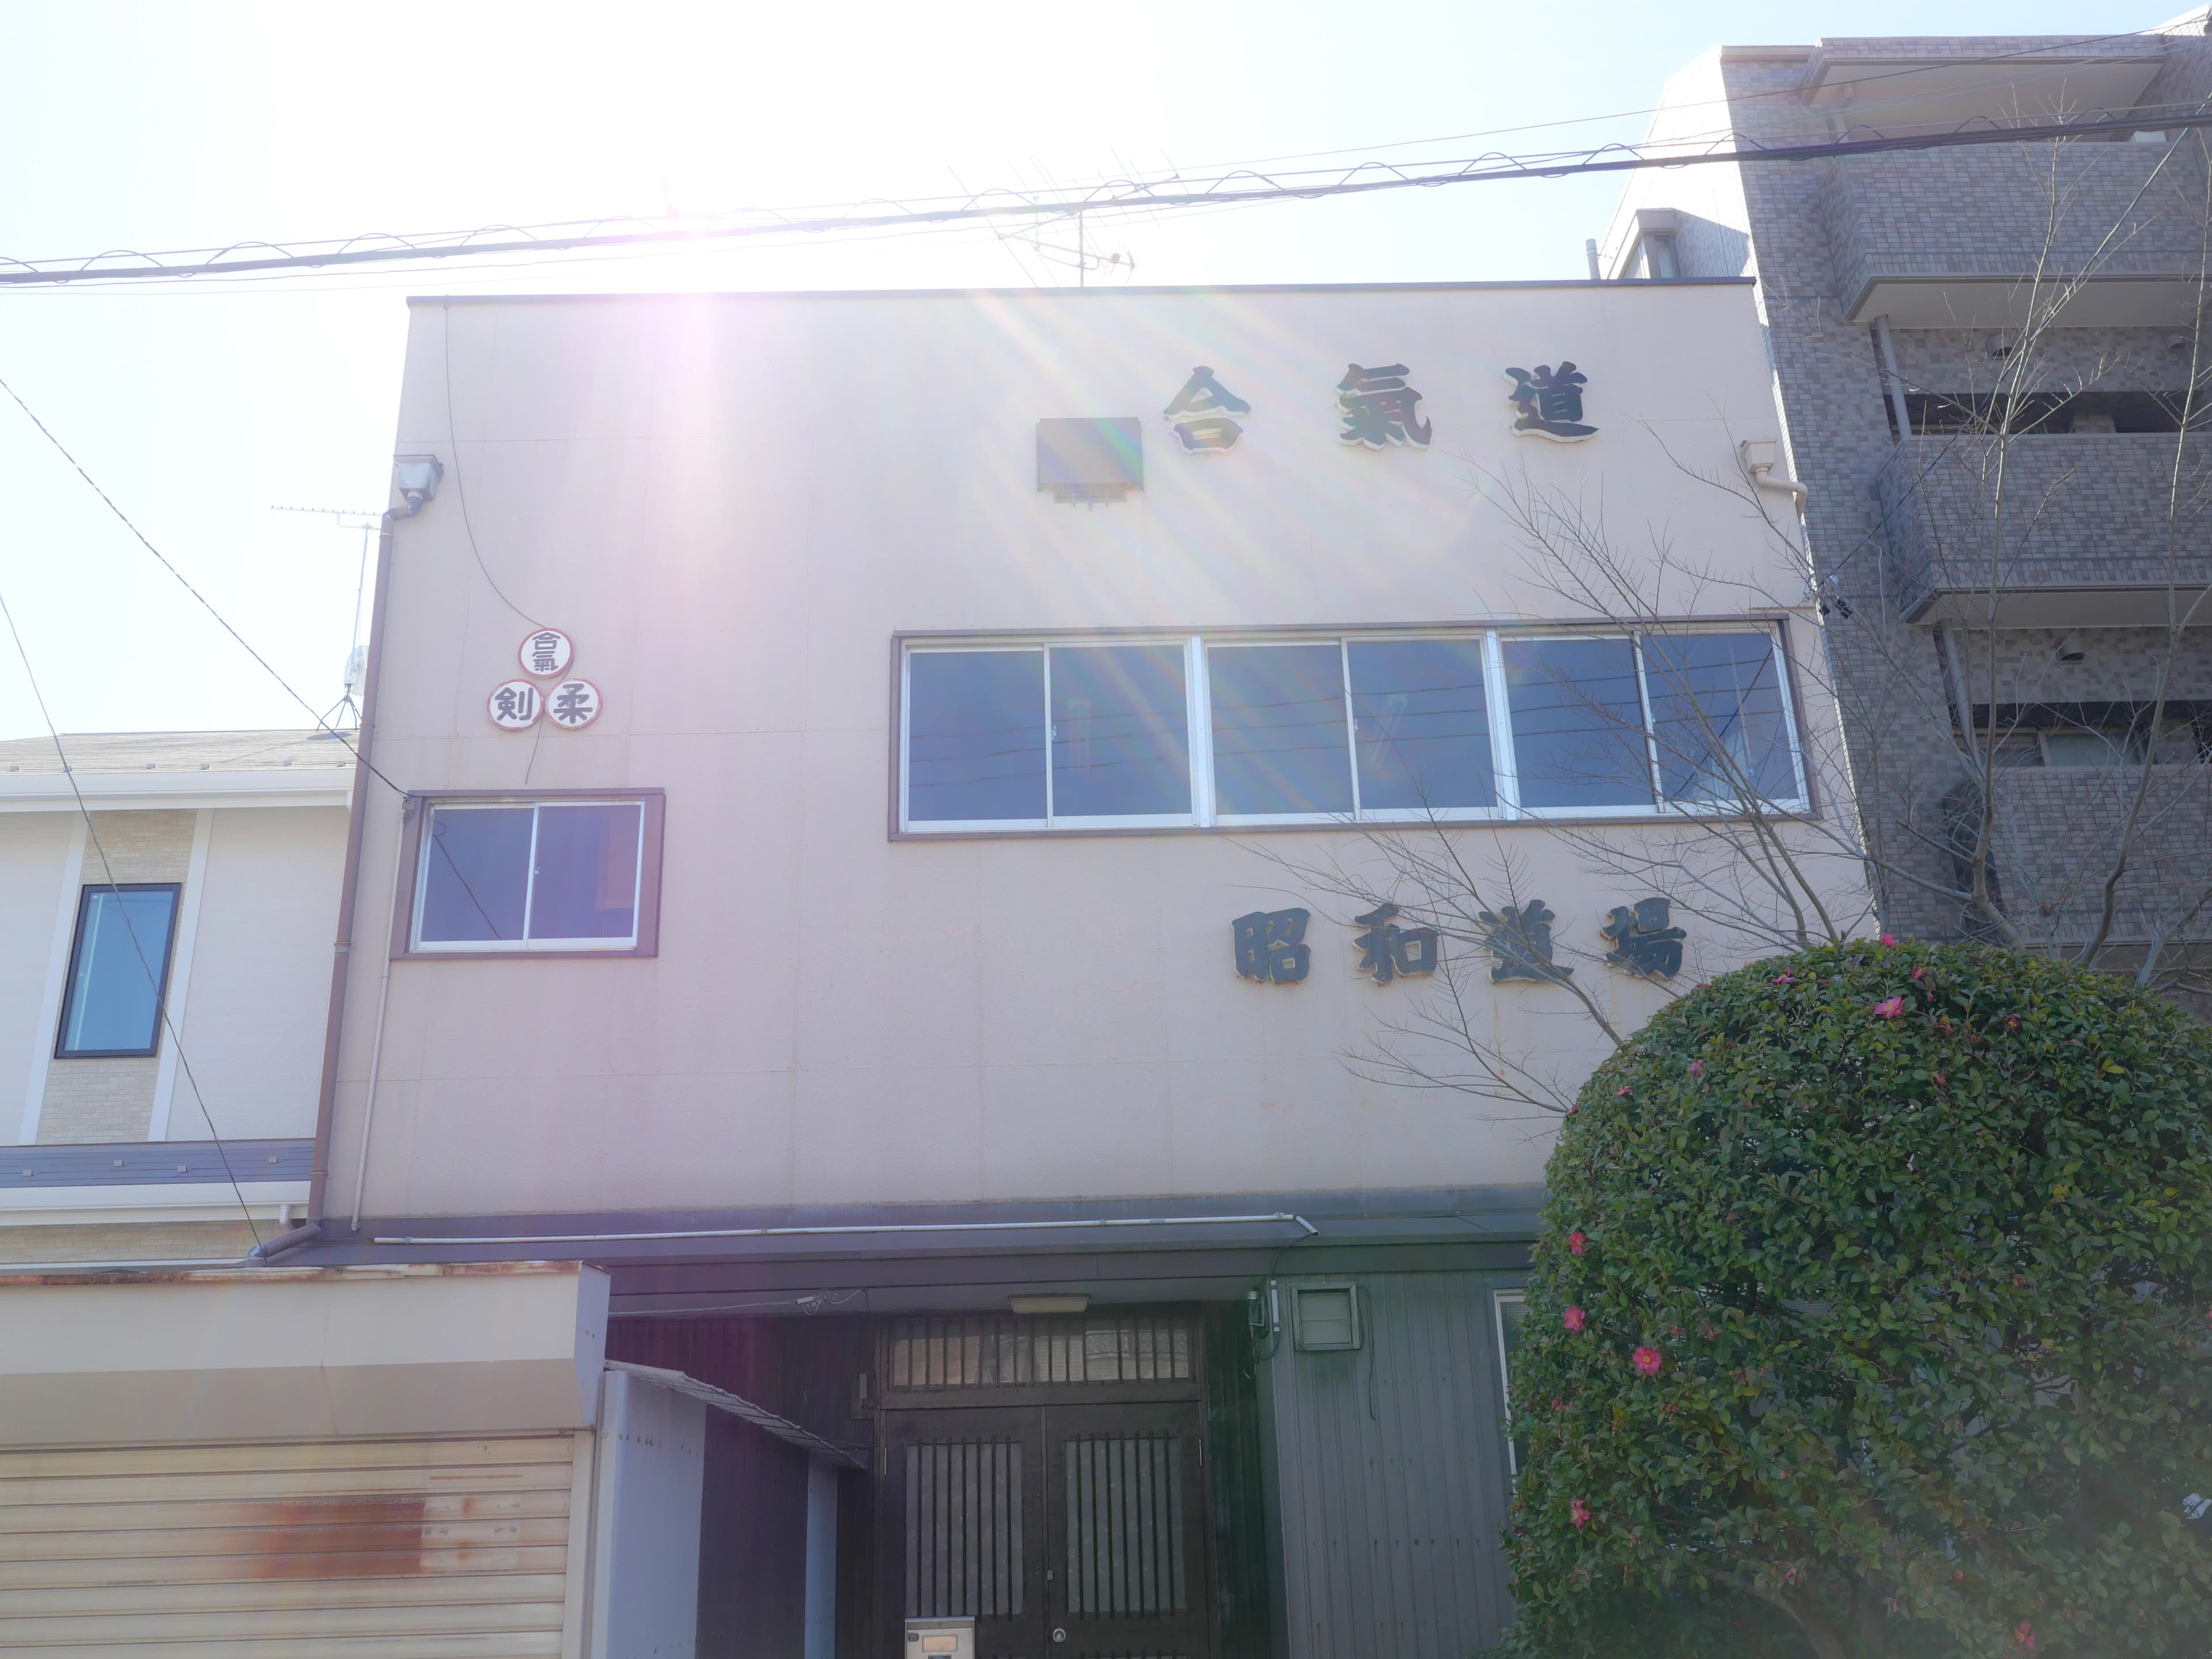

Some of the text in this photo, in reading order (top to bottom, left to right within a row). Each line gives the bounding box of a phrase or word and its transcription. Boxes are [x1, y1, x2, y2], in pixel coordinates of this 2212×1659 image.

[1162, 361, 1600, 452] 合氣道
[494, 687, 534, 721] 剣
[553, 683, 593, 724] 柔
[1232, 897, 1687, 986] 昭和道場
